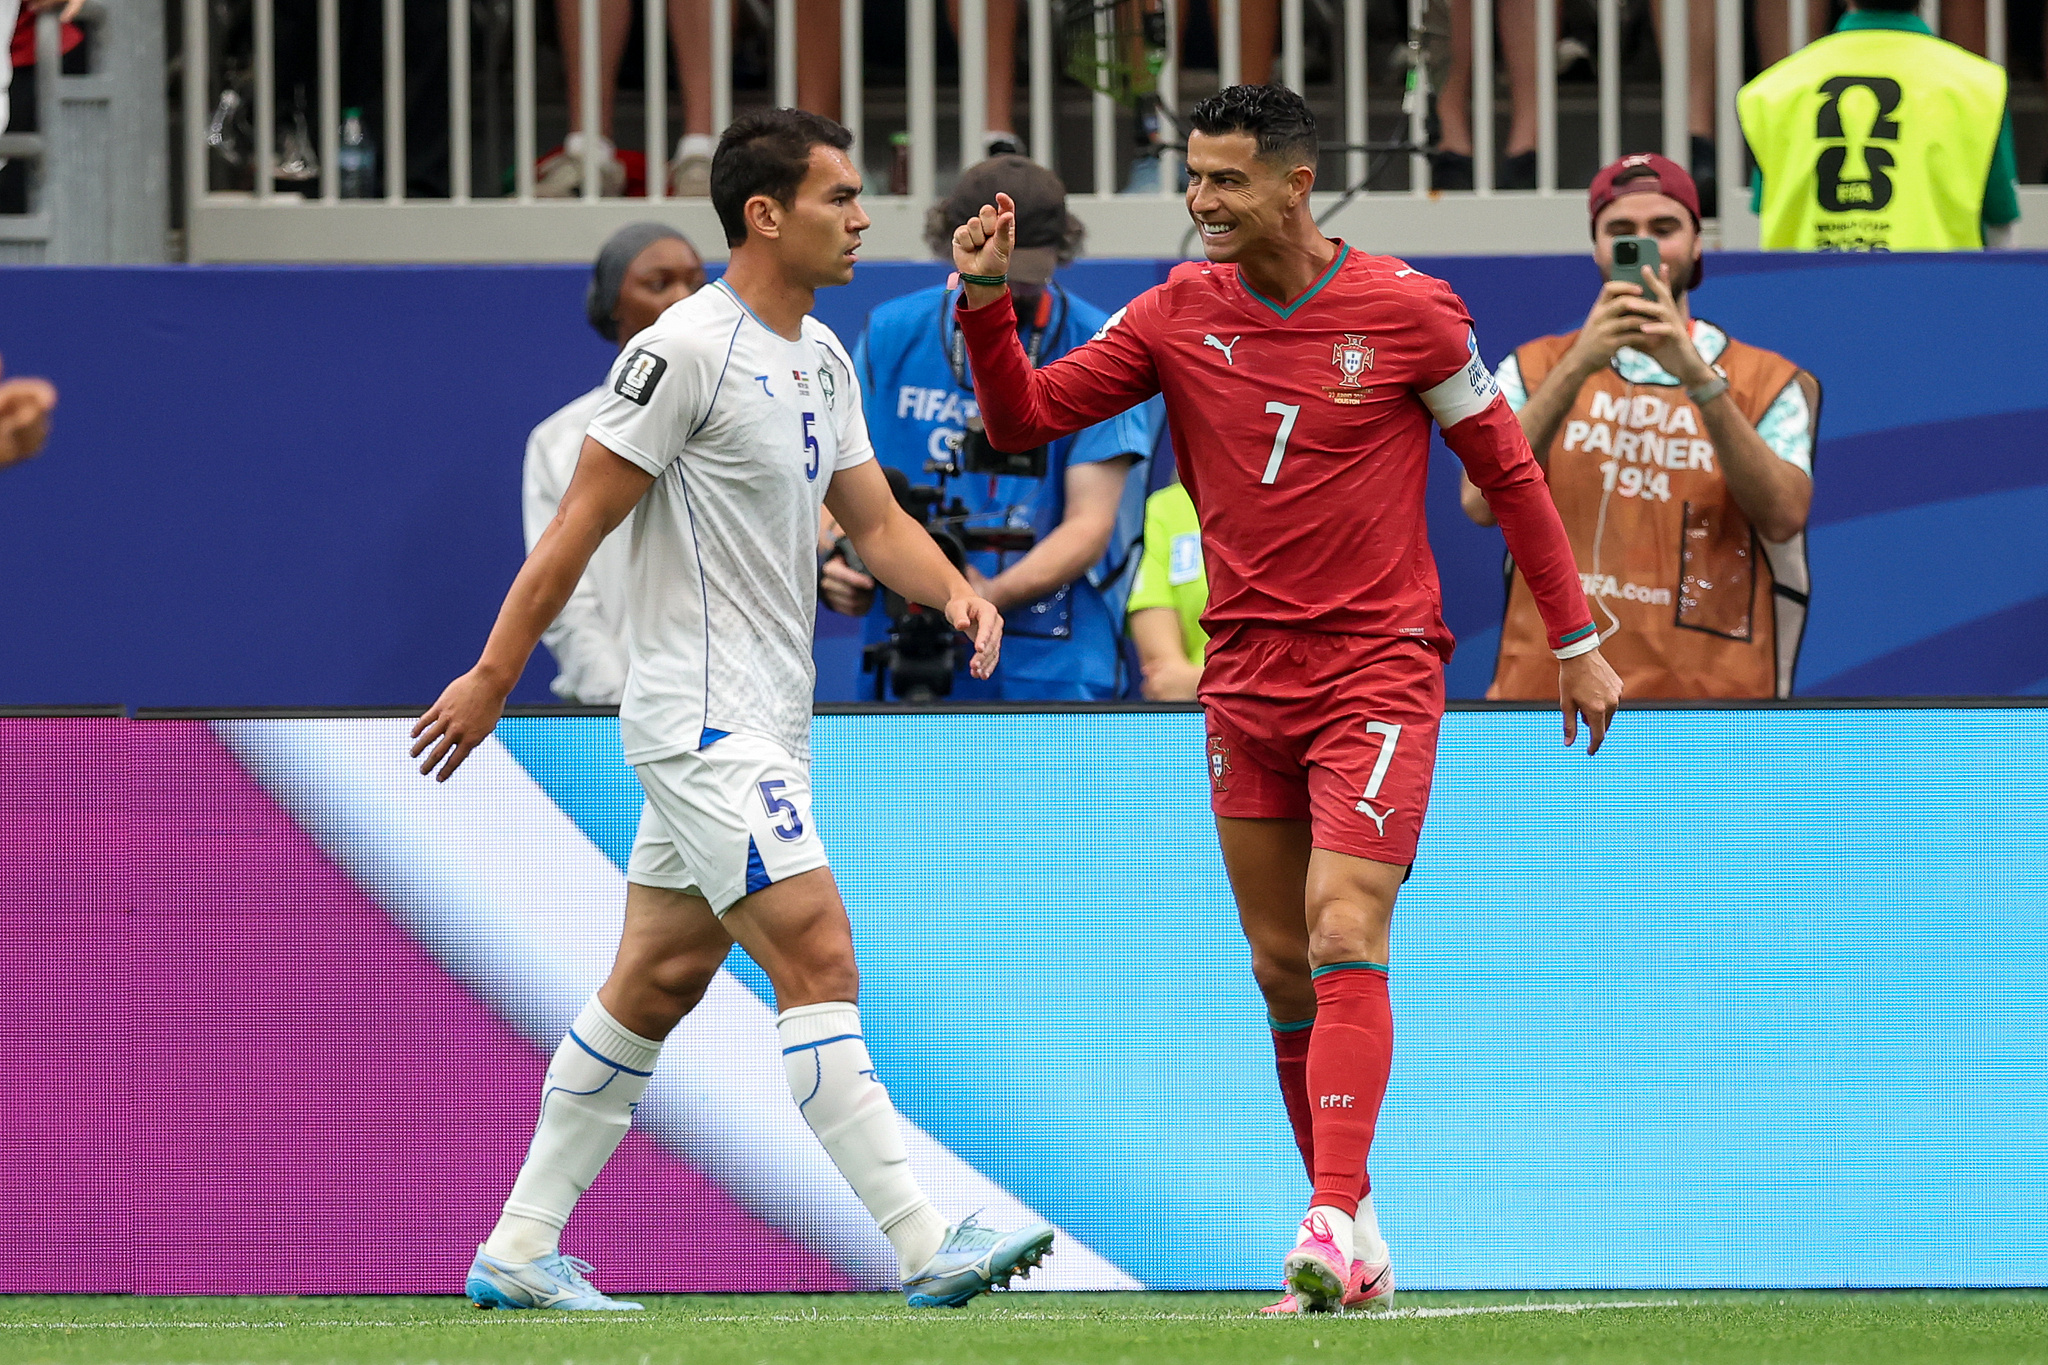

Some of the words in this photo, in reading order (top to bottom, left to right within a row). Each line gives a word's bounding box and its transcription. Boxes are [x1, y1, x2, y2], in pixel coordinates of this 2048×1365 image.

[897, 385, 963, 426] FIFA
[802, 412, 819, 483] 5
[1261, 401, 1300, 484] 7
[1562, 419, 1715, 473] PARNER
[1578, 572, 1671, 607] IFA.com
[1362, 721, 1402, 798] 7
[755, 780, 803, 843] 5
